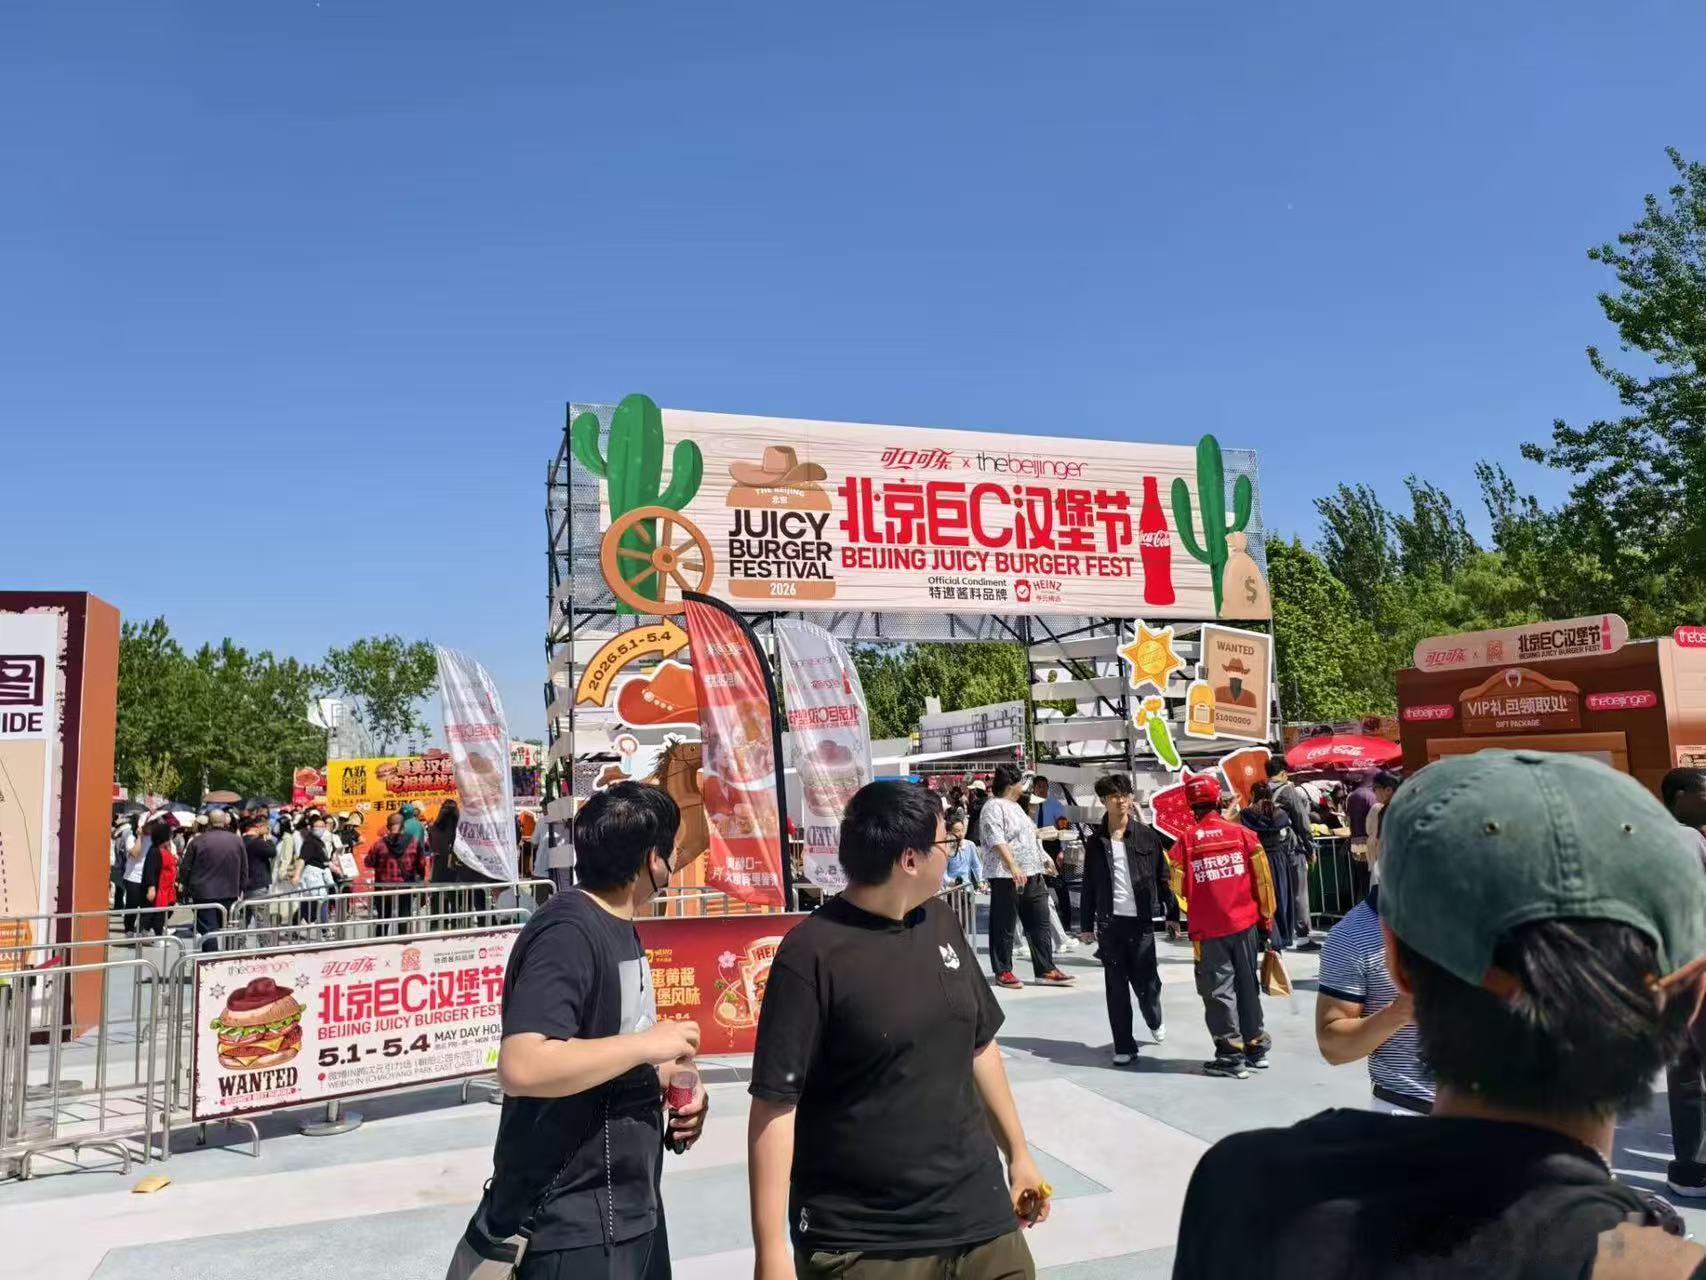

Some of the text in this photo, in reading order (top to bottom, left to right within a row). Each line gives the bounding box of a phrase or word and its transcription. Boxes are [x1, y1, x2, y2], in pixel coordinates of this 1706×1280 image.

[881, 447, 953, 470] 可口可乐
[976, 452, 1089, 480] thebeijinger
[728, 509, 830, 540] JUICY
[838, 476, 1132, 553] 北京巨C汉堡节
[729, 538, 833, 562] BURGER
[729, 559, 834, 580] FESTIVAL
[841, 546, 1134, 578] BEIJING JUICY BURGER FEST
[769, 582, 797, 597] 2026
[928, 576, 1007, 587] Official Condiment
[1033, 579, 1063, 592] HEINZ
[1216, 640, 1255, 656] WANTED
[1518, 625, 1600, 653] 北京巨C汉堡节
[1467, 695, 1569, 718] VIP礼包领取处
[1, 713, 43, 733] IDE
[1511, 719, 1541, 728] PACKAGE
[318, 965, 504, 1024] 北京巨C汉堡节
[655, 986, 701, 1007] 堡风味
[318, 1004, 502, 1041] BEIJING JUICY BURGER FEST
[434, 1024, 503, 1042] MAY DAY HOL
[218, 1067, 298, 1097] WANTED
